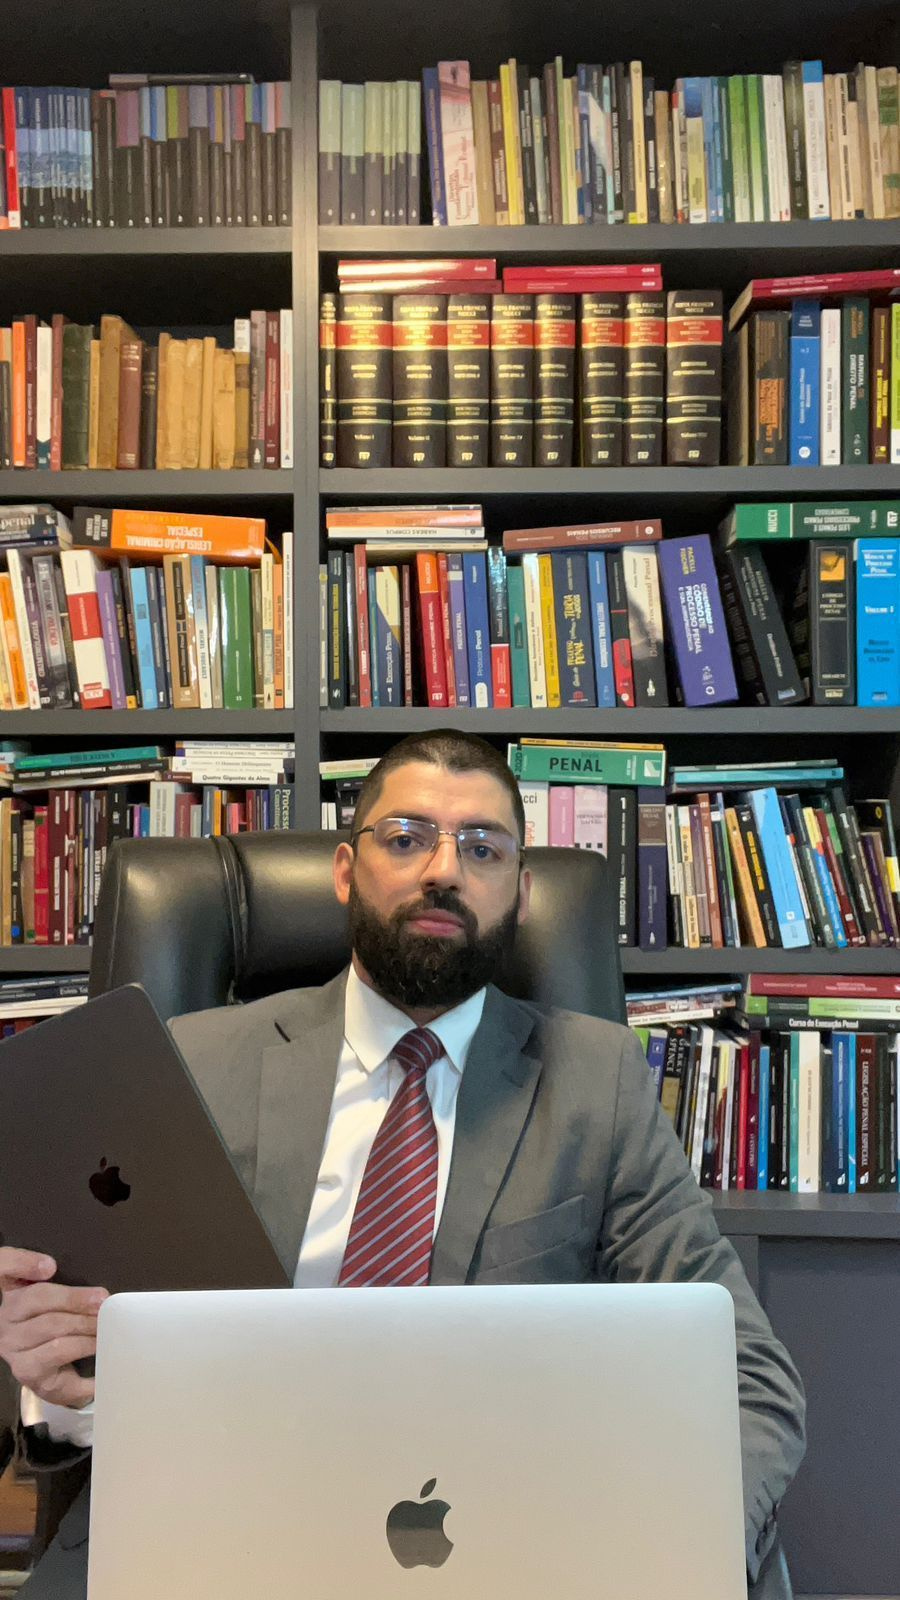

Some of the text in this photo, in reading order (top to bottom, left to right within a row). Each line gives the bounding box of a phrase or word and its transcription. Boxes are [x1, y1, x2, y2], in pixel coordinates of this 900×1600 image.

[166, 526, 203, 536] ESPECIAL
[590, 527, 621, 535] RECURSOS
[768, 510, 778, 532] NUCCI
[127, 535, 212, 551] LEGISLAÇÃO CRIMINAL
[643, 558, 652, 580] Penal
[693, 584, 705, 628] CÓDIGO DE
[598, 622, 607, 638] PENAL
[685, 586, 702, 654] PROCESSO PENAL
[386, 651, 394, 683] Execução
[514, 754, 523, 772] 2020
[550, 757, 603, 773] PENAL
[789, 1018, 806, 1027] Curso
[816, 1019, 841, 1028] Execução
[842, 1019, 858, 1028] Penal
[666, 1038, 677, 1072] SPENCE
[677, 1040, 687, 1073] GERRY
[860, 1061, 869, 1107] LEGISLAÇÃO
